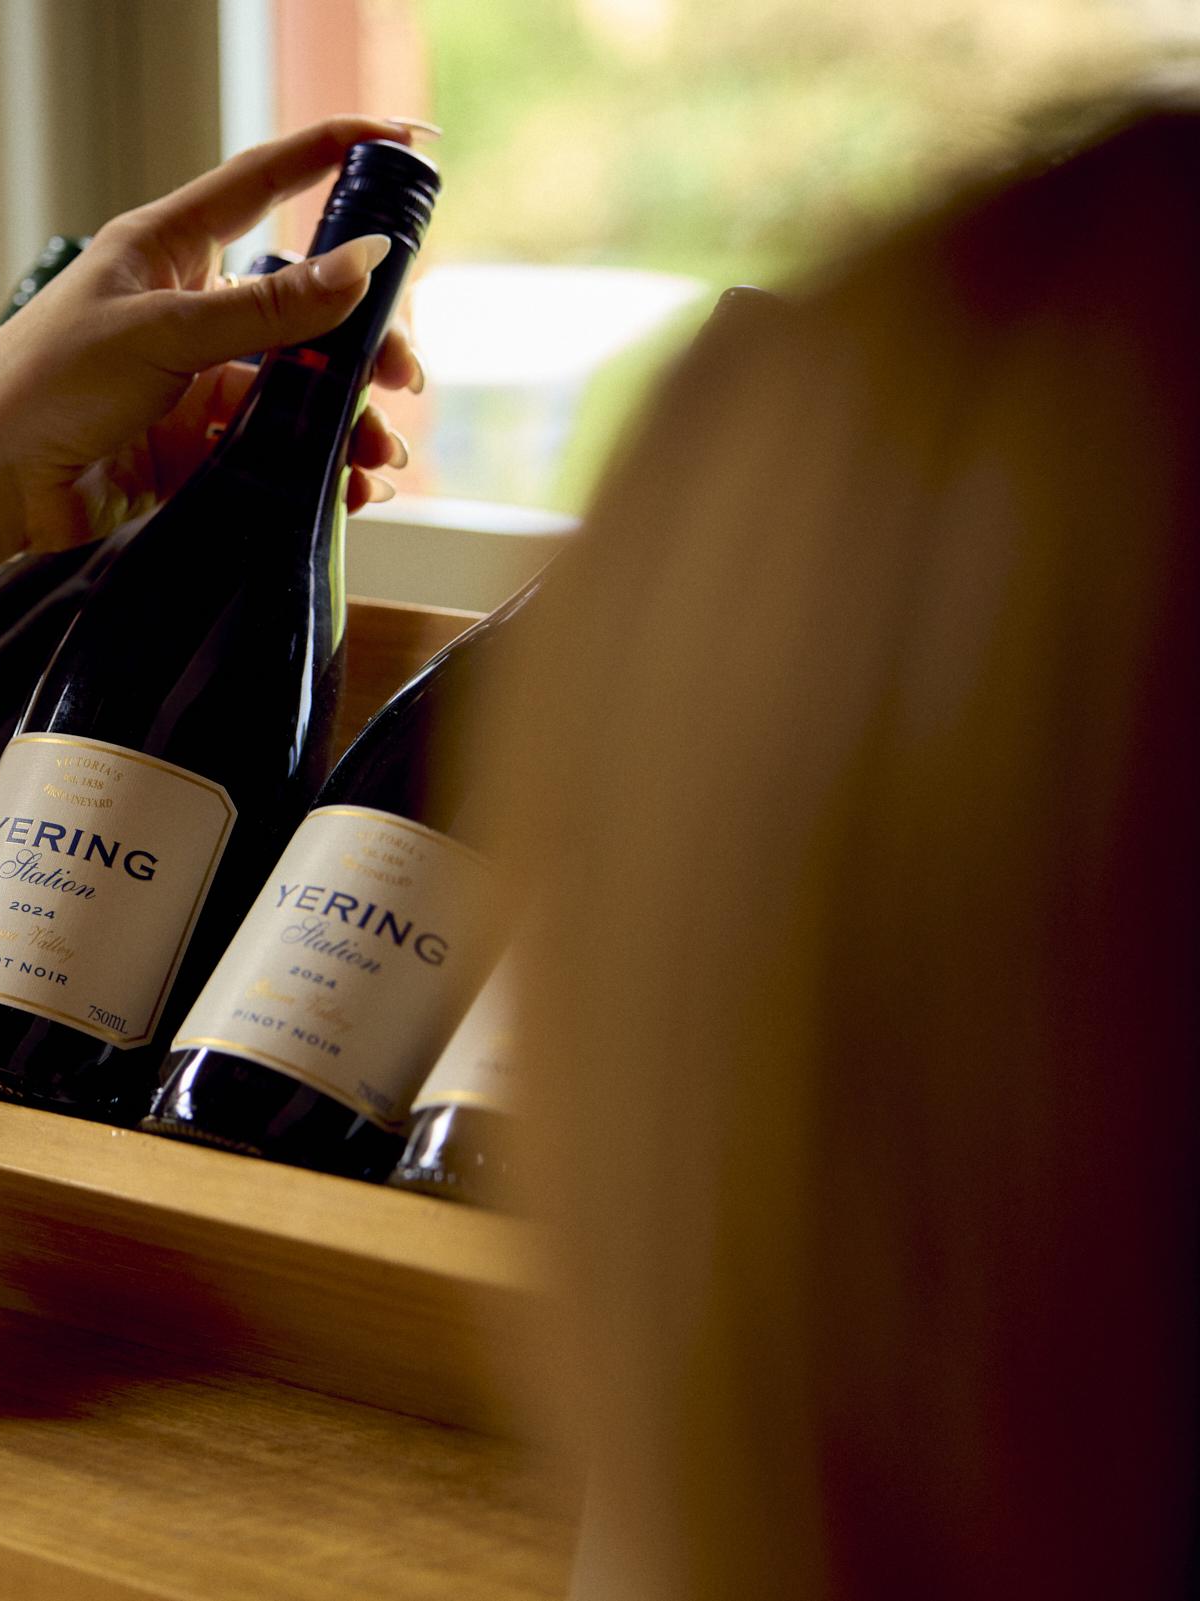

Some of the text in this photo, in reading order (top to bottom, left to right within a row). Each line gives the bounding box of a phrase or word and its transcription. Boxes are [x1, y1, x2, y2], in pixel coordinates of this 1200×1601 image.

[9, 901, 56, 919] 2024
[276, 884, 449, 966] YERING
[28, 924, 76, 963] Valley
[280, 916, 383, 976] Station
[19, 962, 68, 986] NOIR
[289, 966, 337, 989] 2024
[88, 1005, 128, 1034] 750mL
[232, 1008, 286, 1031] PINOT
[292, 1026, 342, 1056] NOIR
